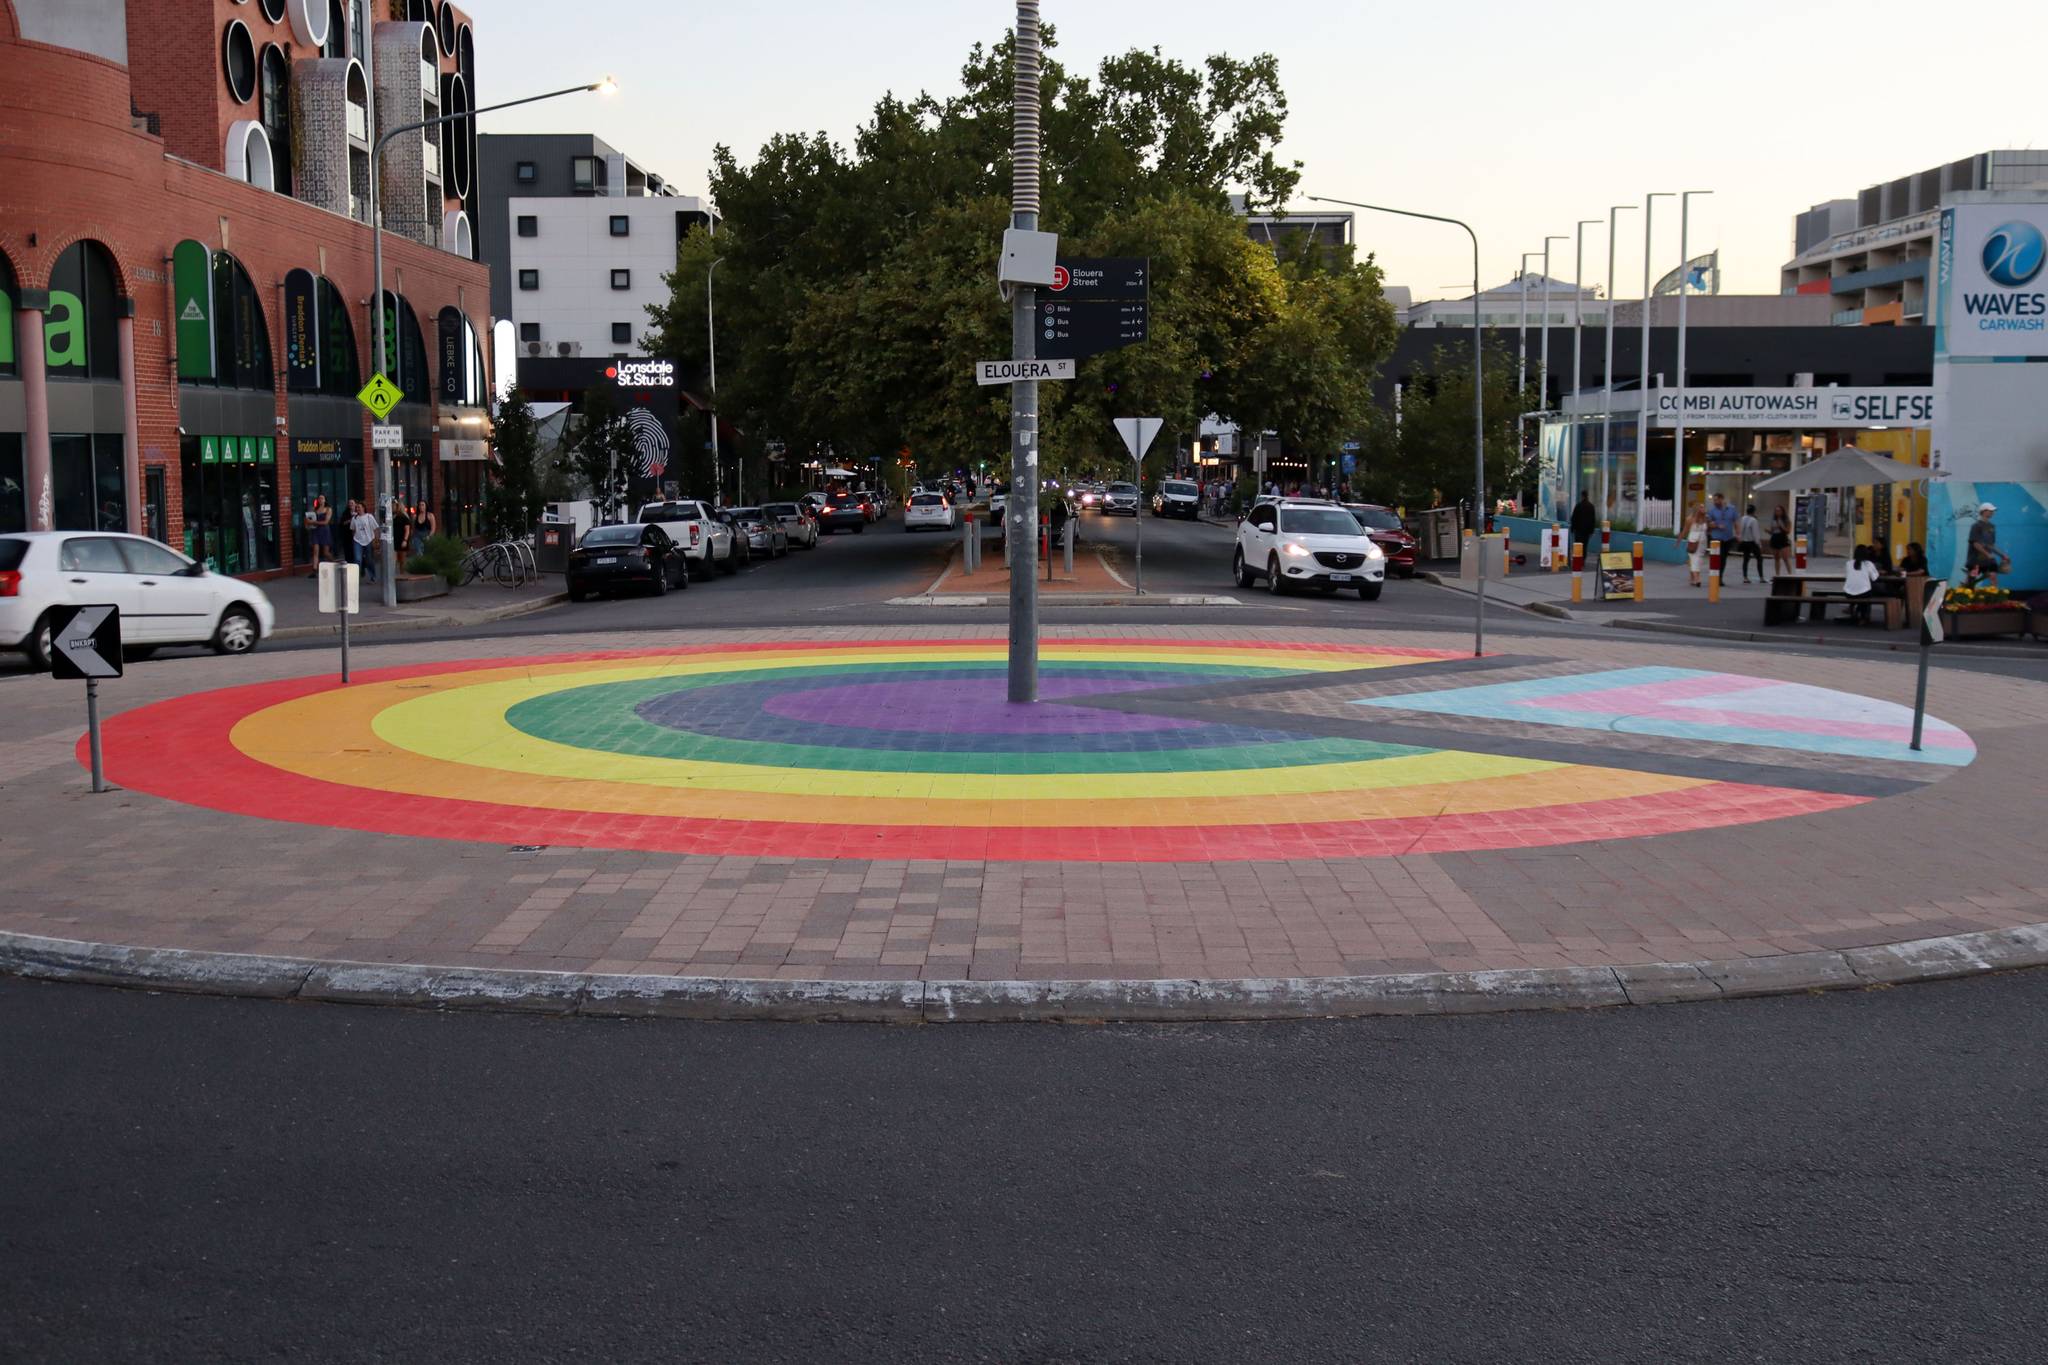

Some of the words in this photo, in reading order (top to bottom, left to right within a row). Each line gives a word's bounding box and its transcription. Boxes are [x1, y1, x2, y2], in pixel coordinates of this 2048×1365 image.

[1940, 215, 1952, 285] WAVES
[1073, 268, 1103, 277] Elouera
[1073, 277, 1098, 286] Street
[1963, 293, 2046, 315] WAVES
[296, 295, 305, 332] Braddon
[1979, 319, 2045, 330] CARWASH
[446, 336, 456, 368] LIEBKE
[617, 360, 674, 374] Lonsdale
[985, 363, 1051, 378] ELOUERA
[1057, 362, 1066, 370] ST
[447, 377, 456, 392] CO
[1719, 395, 1818, 410] AUTOWASH
[297, 439, 319, 453] Braddon
